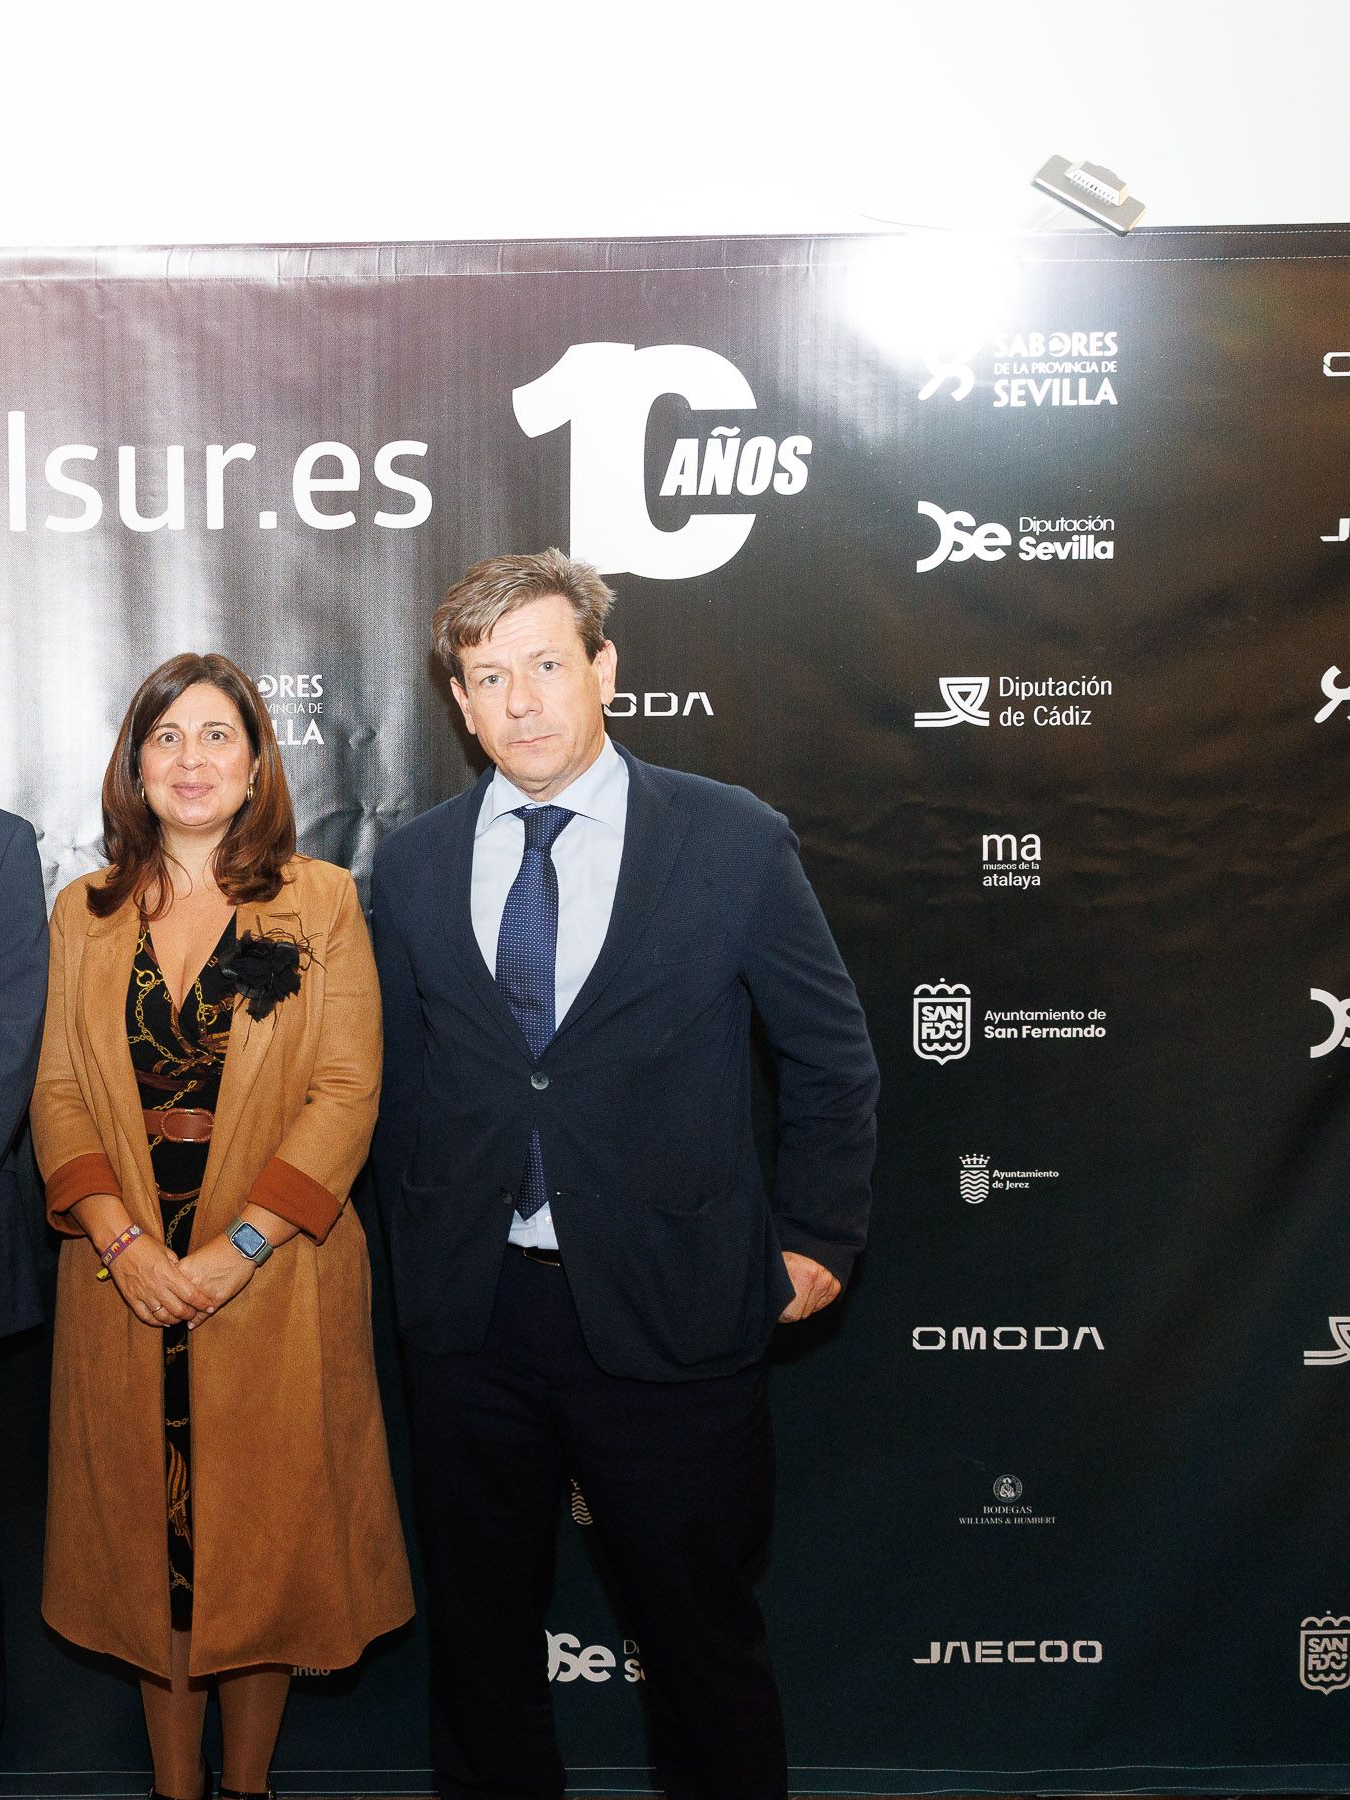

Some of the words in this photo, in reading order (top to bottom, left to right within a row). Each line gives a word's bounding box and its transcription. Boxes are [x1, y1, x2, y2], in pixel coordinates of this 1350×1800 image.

[994, 332, 1118, 357] SABORES
[993, 362, 1012, 376] DE
[1013, 362, 1029, 376] LA
[1030, 362, 1099, 375] PROVINCIA
[1101, 360, 1119, 374] DE
[993, 377, 1119, 407] SEVILLA
[659, 426, 813, 498] AÑOS
[1020, 515, 1114, 534] Diputación
[1019, 534, 1114, 560] Sevilla
[1000, 676, 1112, 700] Diputación
[308, 702, 324, 714] DE
[1000, 707, 1024, 726] de
[1034, 706, 1091, 726] Cádiz
[983, 834, 1041, 861] ma
[983, 872, 1040, 889] atalaya
[985, 1009, 1084, 1024] Ayuntamiento
[1088, 1009, 1106, 1020] de
[985, 1024, 1017, 1039] San
[1022, 1025, 1106, 1038] Fernando
[993, 1170, 1059, 1180] Ayuntamiento
[1006, 1181, 1029, 1190] Jerez
[913, 1327, 1104, 1350] OMODA
[959, 1517, 1003, 1526] WILLIAMS
[913, 1641, 1102, 1663] JAECOO
